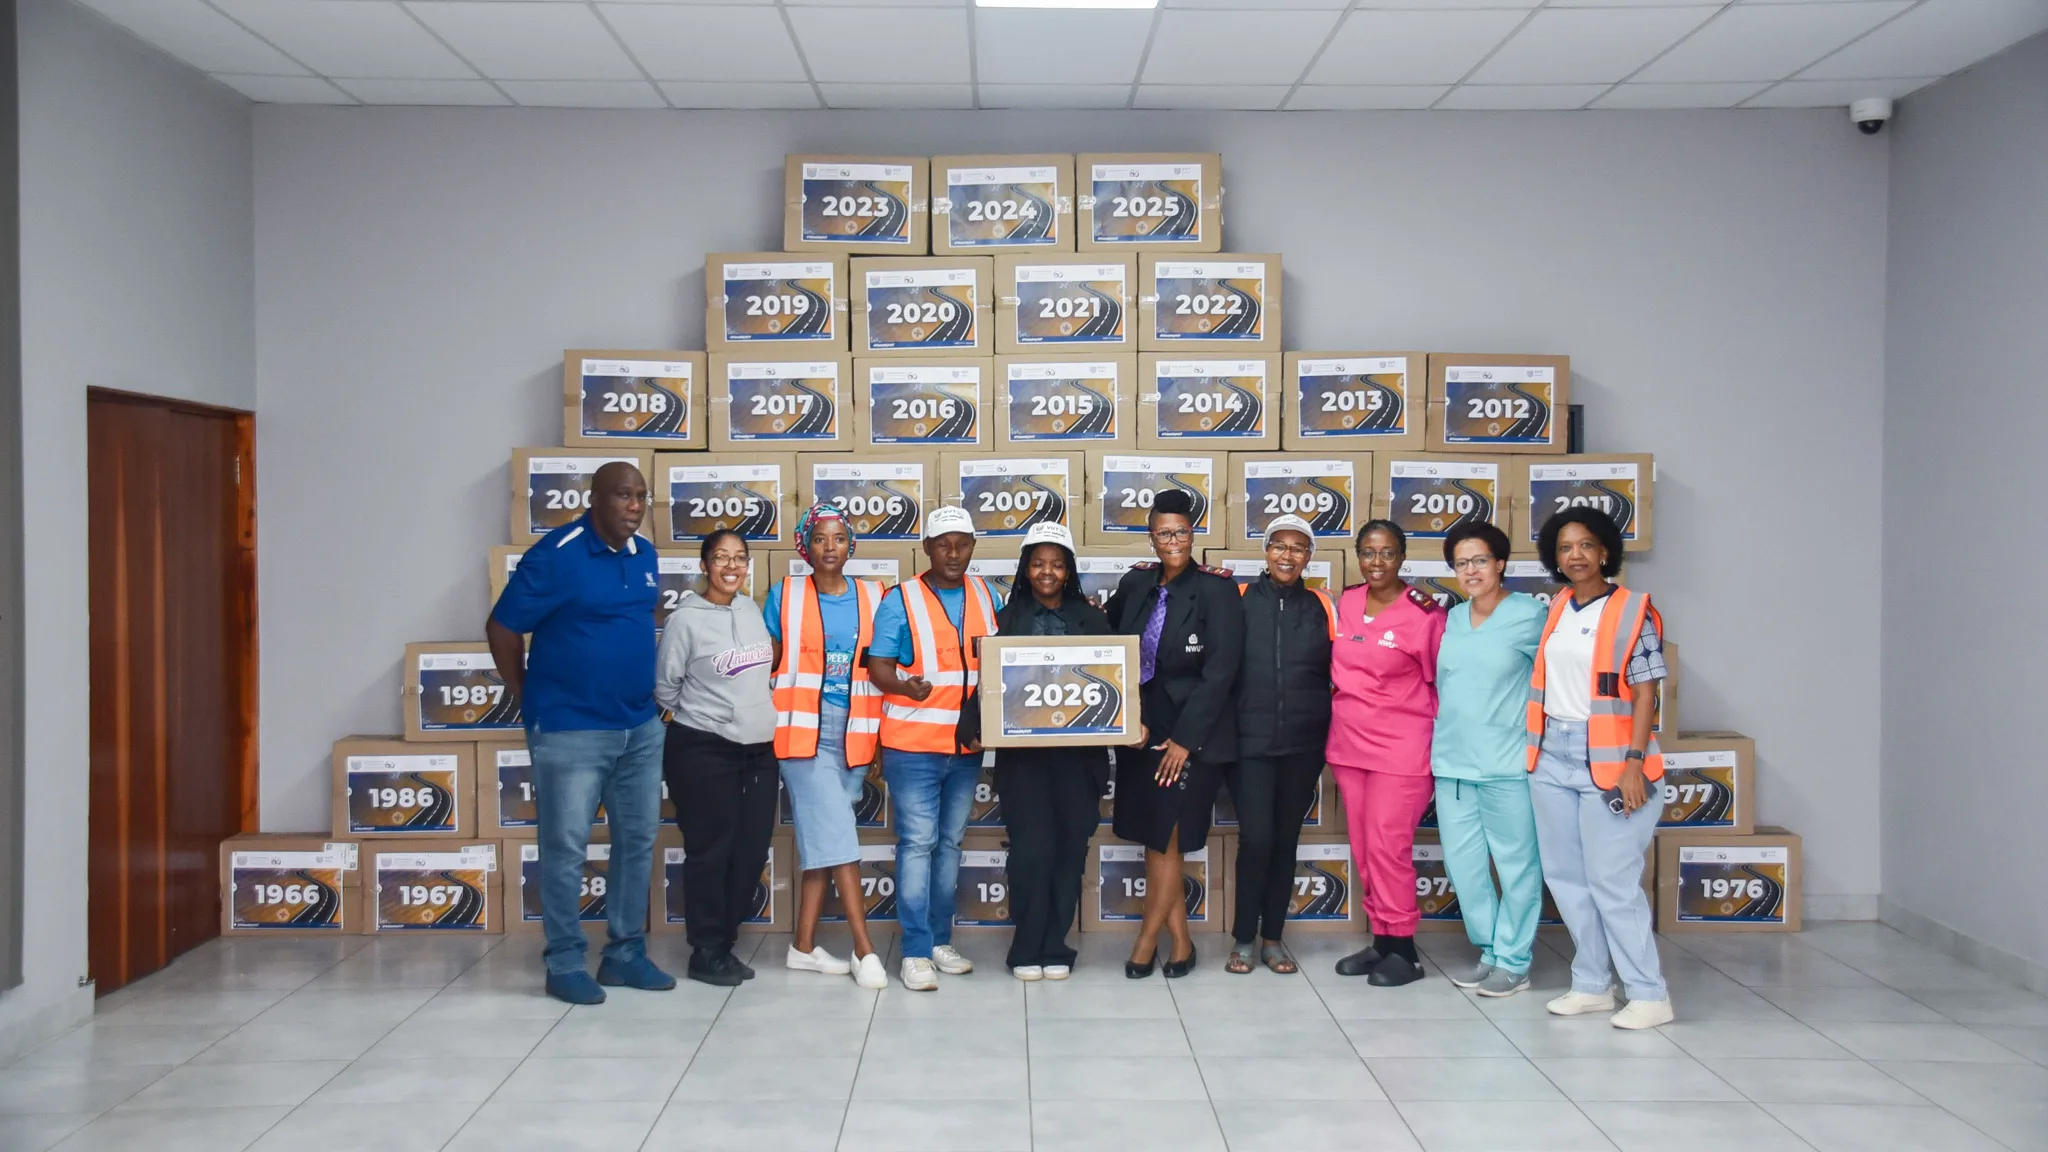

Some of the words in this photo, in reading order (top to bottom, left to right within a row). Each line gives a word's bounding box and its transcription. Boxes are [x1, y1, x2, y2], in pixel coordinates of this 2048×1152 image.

[822, 196, 889, 218] 2023
[967, 199, 1038, 221] 2024
[1112, 196, 1179, 217] 2025
[745, 294, 810, 316] 2019
[886, 301, 956, 324] 2020
[1038, 296, 1100, 318] 2021
[1175, 294, 1242, 315] 2022
[603, 392, 667, 414] 2018
[750, 394, 814, 415] 2017
[892, 398, 956, 420] 2016
[1031, 394, 1093, 416] 2015
[1177, 392, 1243, 413] 2014
[1321, 390, 1383, 412] 2013
[1467, 398, 1529, 419] 2012
[545, 489, 593, 510] 200
[688, 496, 761, 518] 2005
[831, 495, 903, 517] 2006
[978, 490, 1049, 512] 2007
[1120, 487, 1192, 509] 20
[1263, 492, 1333, 515] 2009
[1411, 493, 1474, 515] 2010
[440, 685, 505, 706] 1987
[1023, 682, 1102, 707] 2026
[368, 787, 434, 808] 1986
[1662, 783, 1713, 805] 977
[254, 884, 320, 905] 1966
[399, 885, 464, 906] 1967
[579, 876, 607, 897] 68
[977, 883, 1006, 903] 19
[1121, 877, 1147, 898] 19
[1294, 876, 1327, 896] 73
[1415, 876, 1456, 897] 97
[1700, 878, 1764, 899] 1976
